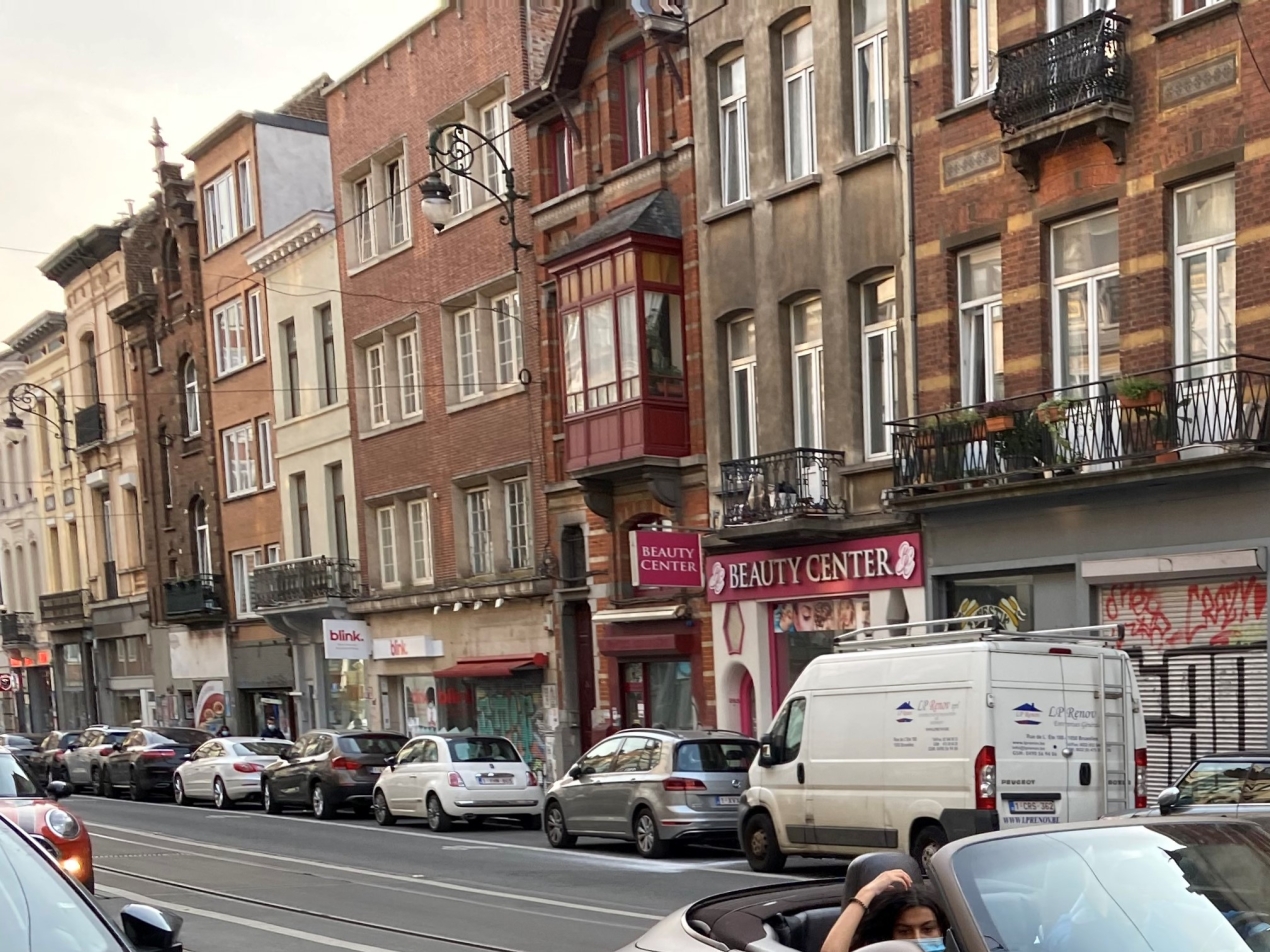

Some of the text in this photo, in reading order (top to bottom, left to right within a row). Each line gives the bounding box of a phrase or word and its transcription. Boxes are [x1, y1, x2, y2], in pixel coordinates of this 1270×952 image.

[642, 546, 694, 559] BEAUTY
[640, 559, 698, 573] CENTER
[729, 547, 893, 589] BEAUTY CENTER
[329, 629, 364, 642] blink.
[1048, 706, 1097, 720] LP Renov
